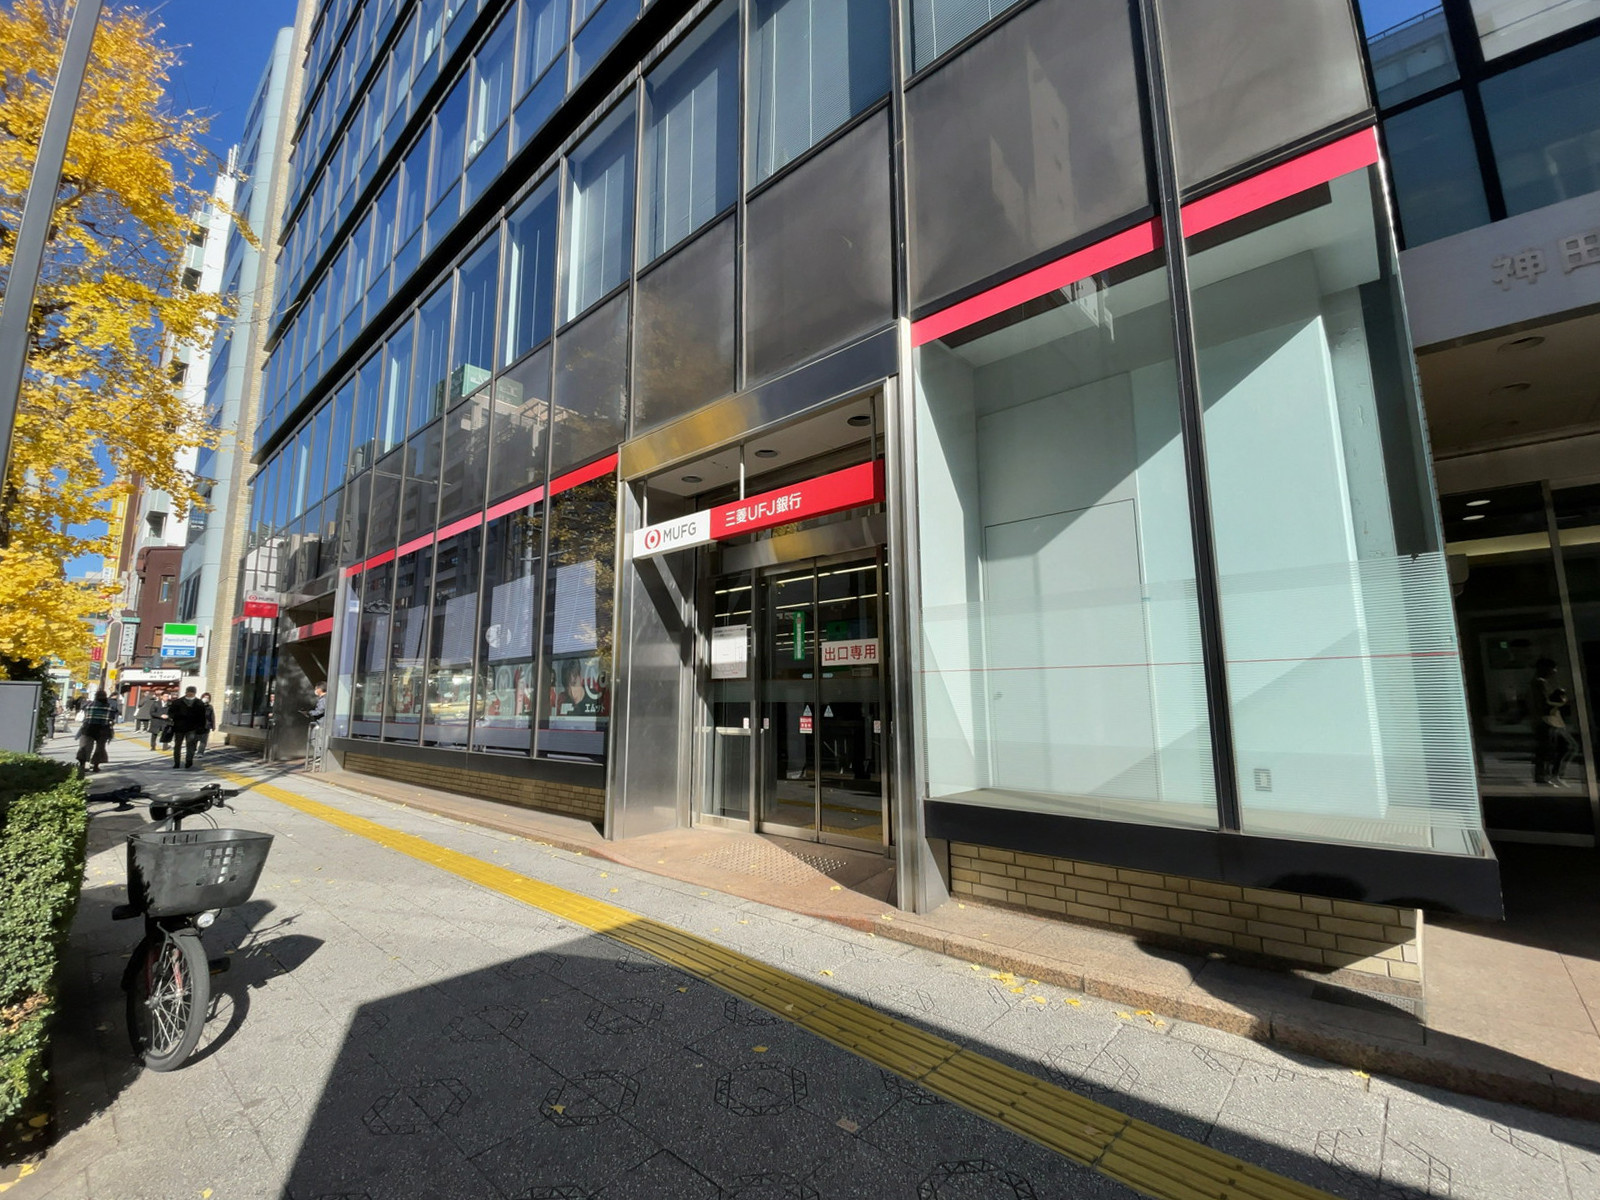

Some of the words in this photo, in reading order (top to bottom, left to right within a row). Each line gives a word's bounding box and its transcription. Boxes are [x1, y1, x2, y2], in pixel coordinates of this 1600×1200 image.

[725, 492, 802, 527] 三菱UFJ銀行
[663, 522, 697, 543] MUFG
[825, 644, 876, 661] 出口専用
